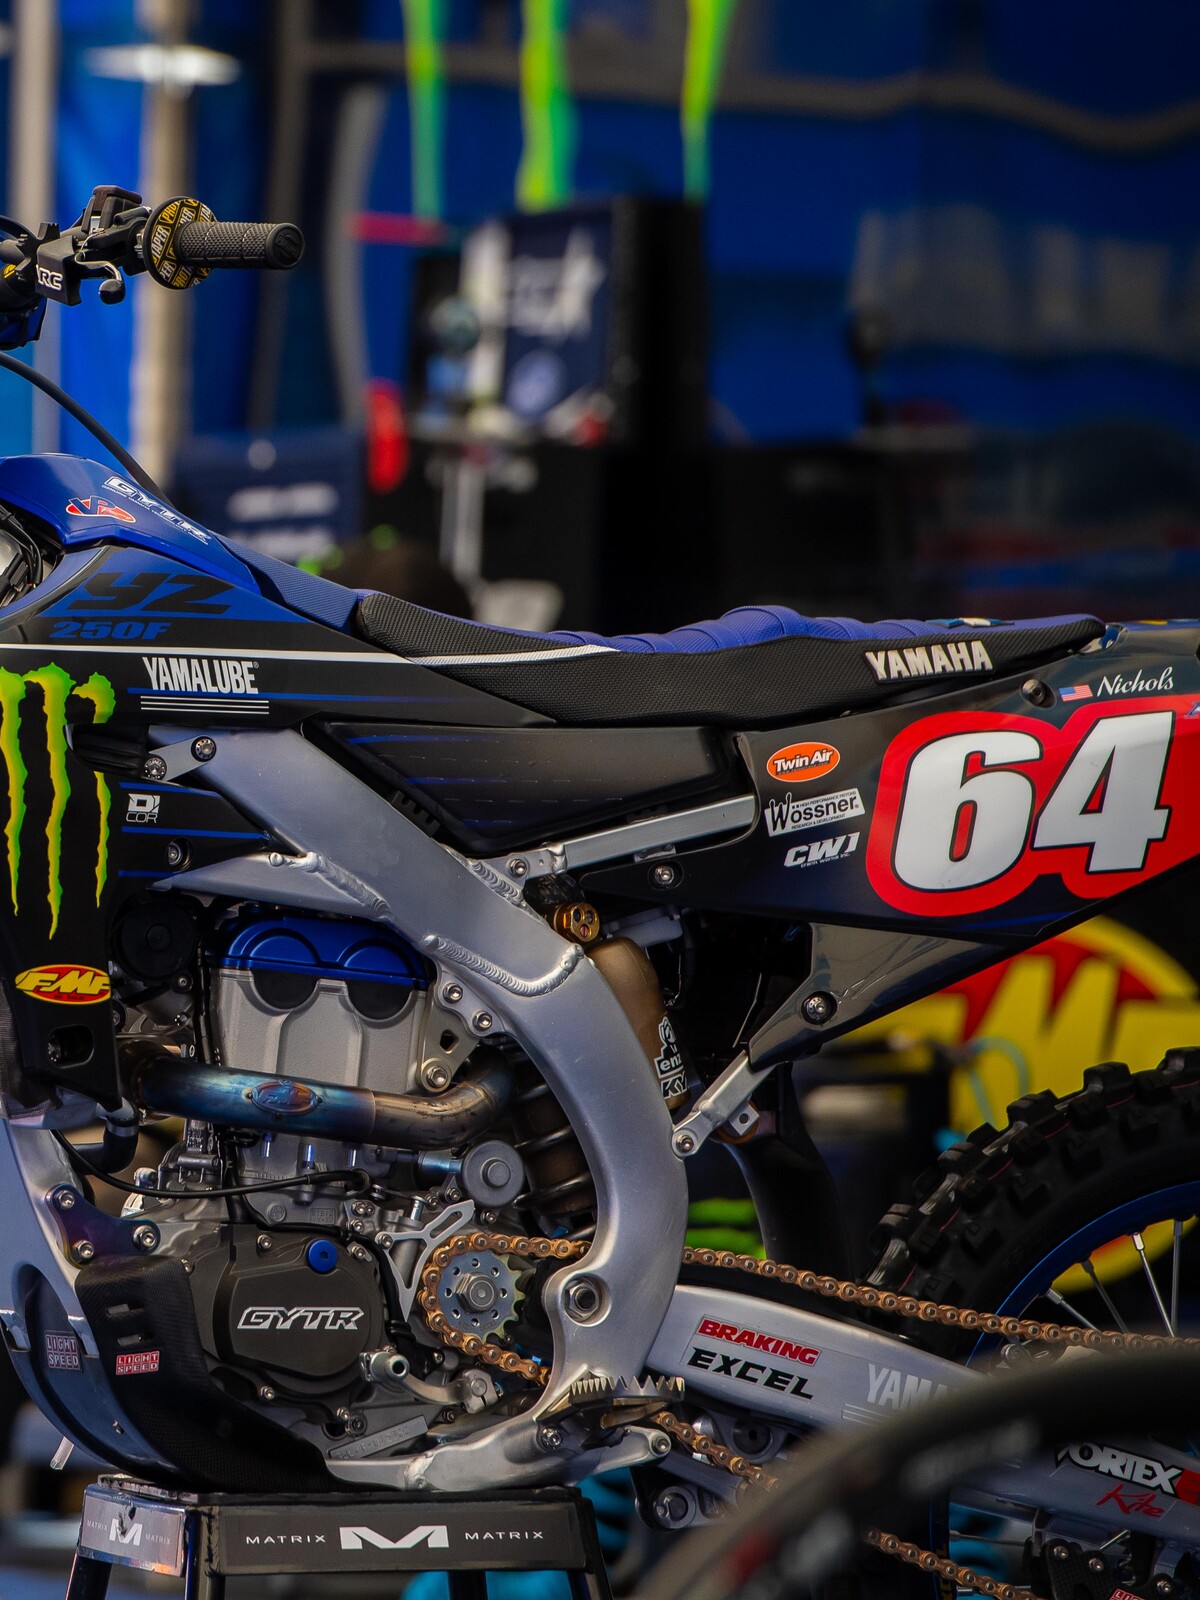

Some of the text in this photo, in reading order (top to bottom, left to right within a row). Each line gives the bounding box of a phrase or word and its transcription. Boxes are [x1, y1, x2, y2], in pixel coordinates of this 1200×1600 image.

[68, 495, 117, 517] VP
[104, 475, 212, 540] GYTR
[50, 620, 172, 641] 250F
[865, 640, 994, 681] YAMAHA
[1097, 666, 1174, 697] Nichols
[773, 753, 809, 774] Twin
[810, 748, 834, 765] Air
[890, 710, 1174, 892] 64
[126, 811, 158, 823] COR
[15, 970, 110, 995] FMF
[236, 1306, 364, 1330] GYTR
[45, 1335, 76, 1352] LIGHT
[697, 1318, 821, 1367] BRAKING
[48, 1352, 79, 1369] SPEED
[116, 1362, 158, 1375] SPEED
[117, 1352, 159, 1365] LIGHT
[686, 1346, 815, 1400] EXCEL
[87, 1520, 108, 1532] MATRIX
[145, 1533, 171, 1545] MATRIX
[245, 1533, 327, 1545] MATRIX
[464, 1531, 545, 1541] MATRIX
